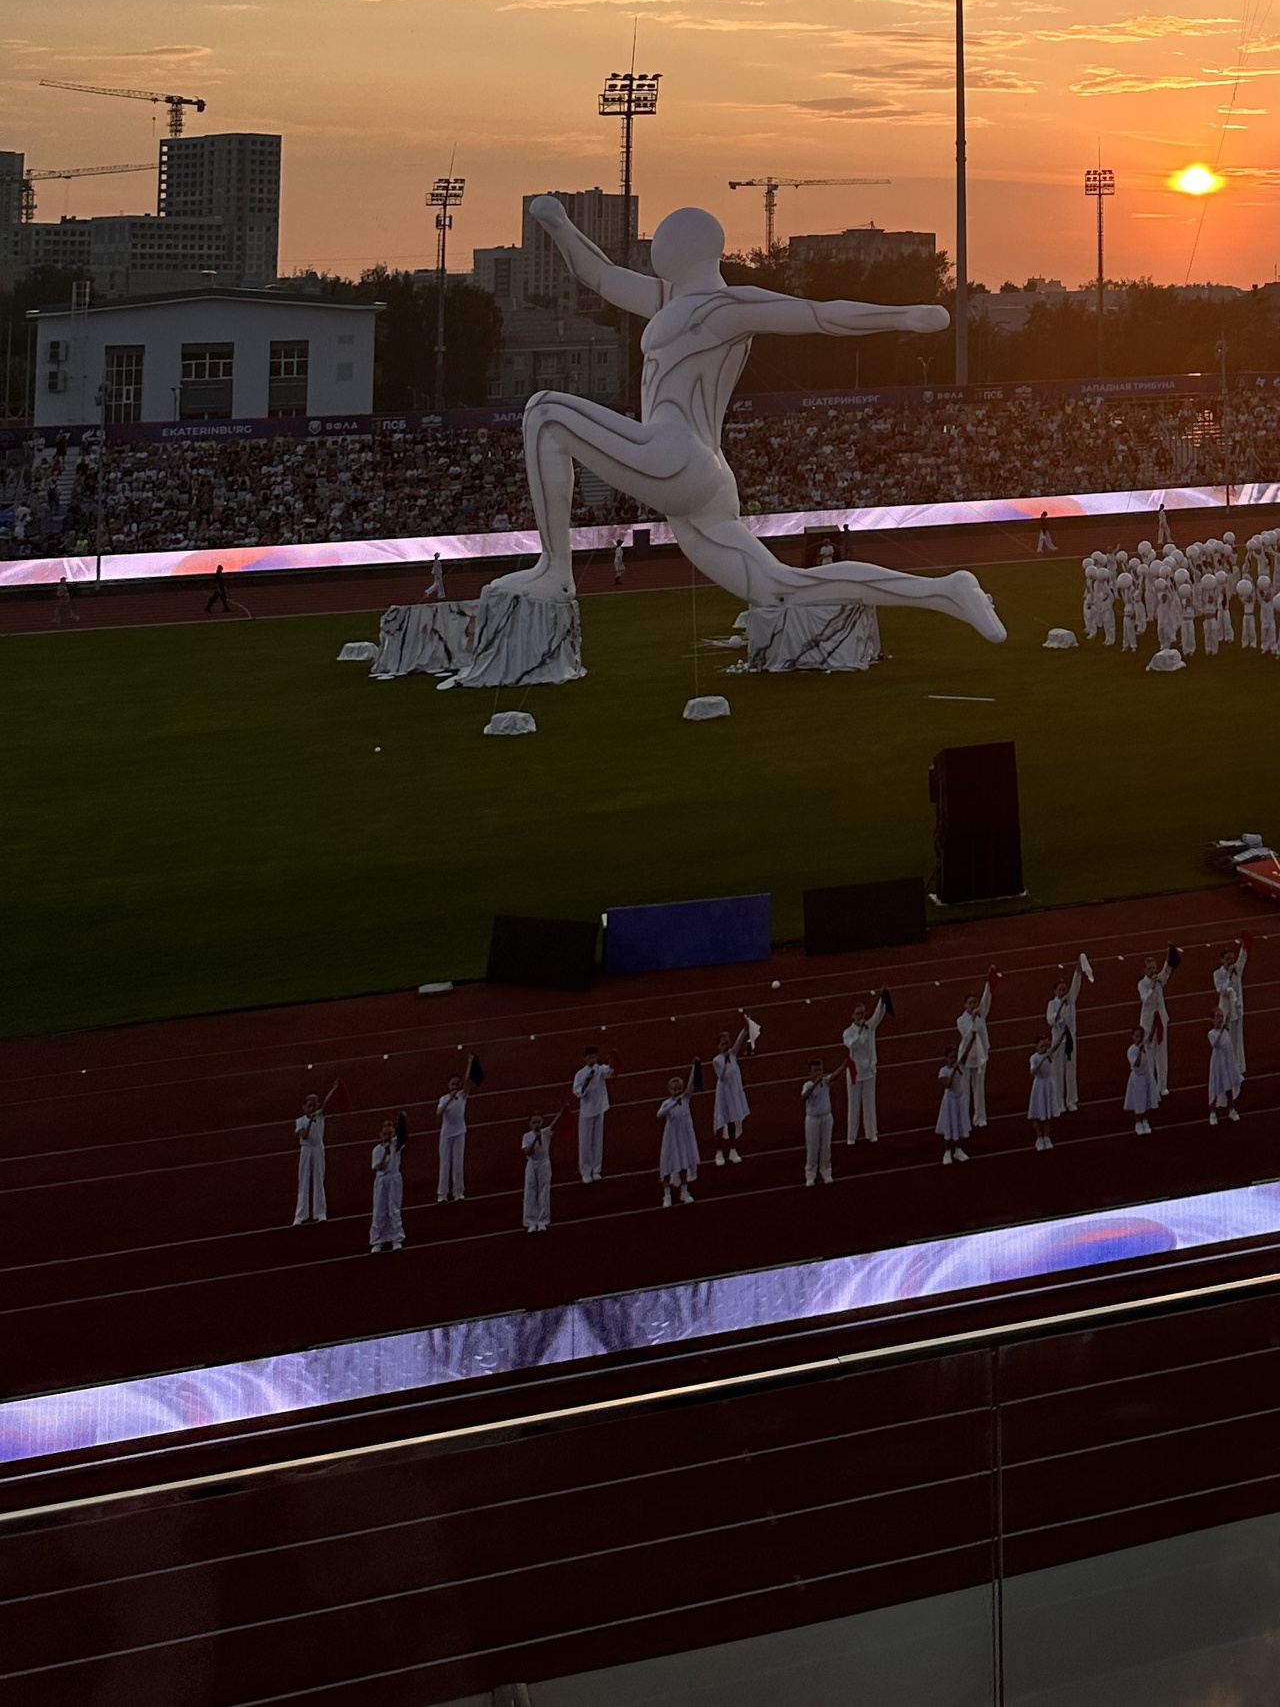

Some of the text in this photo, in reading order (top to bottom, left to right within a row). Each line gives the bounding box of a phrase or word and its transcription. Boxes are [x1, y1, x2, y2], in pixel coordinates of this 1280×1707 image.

[1080, 380, 1175, 393] ЗАПАДНАЯ ТРИБУНА
[983, 390, 1003, 400] ПСБ
[802, 395, 880, 407] ЕКАТЕРИНБУРГ
[325, 421, 358, 431] ВФЛА
[382, 419, 407, 430] ПСБ
[162, 425, 252, 437] EKATERINBURG
